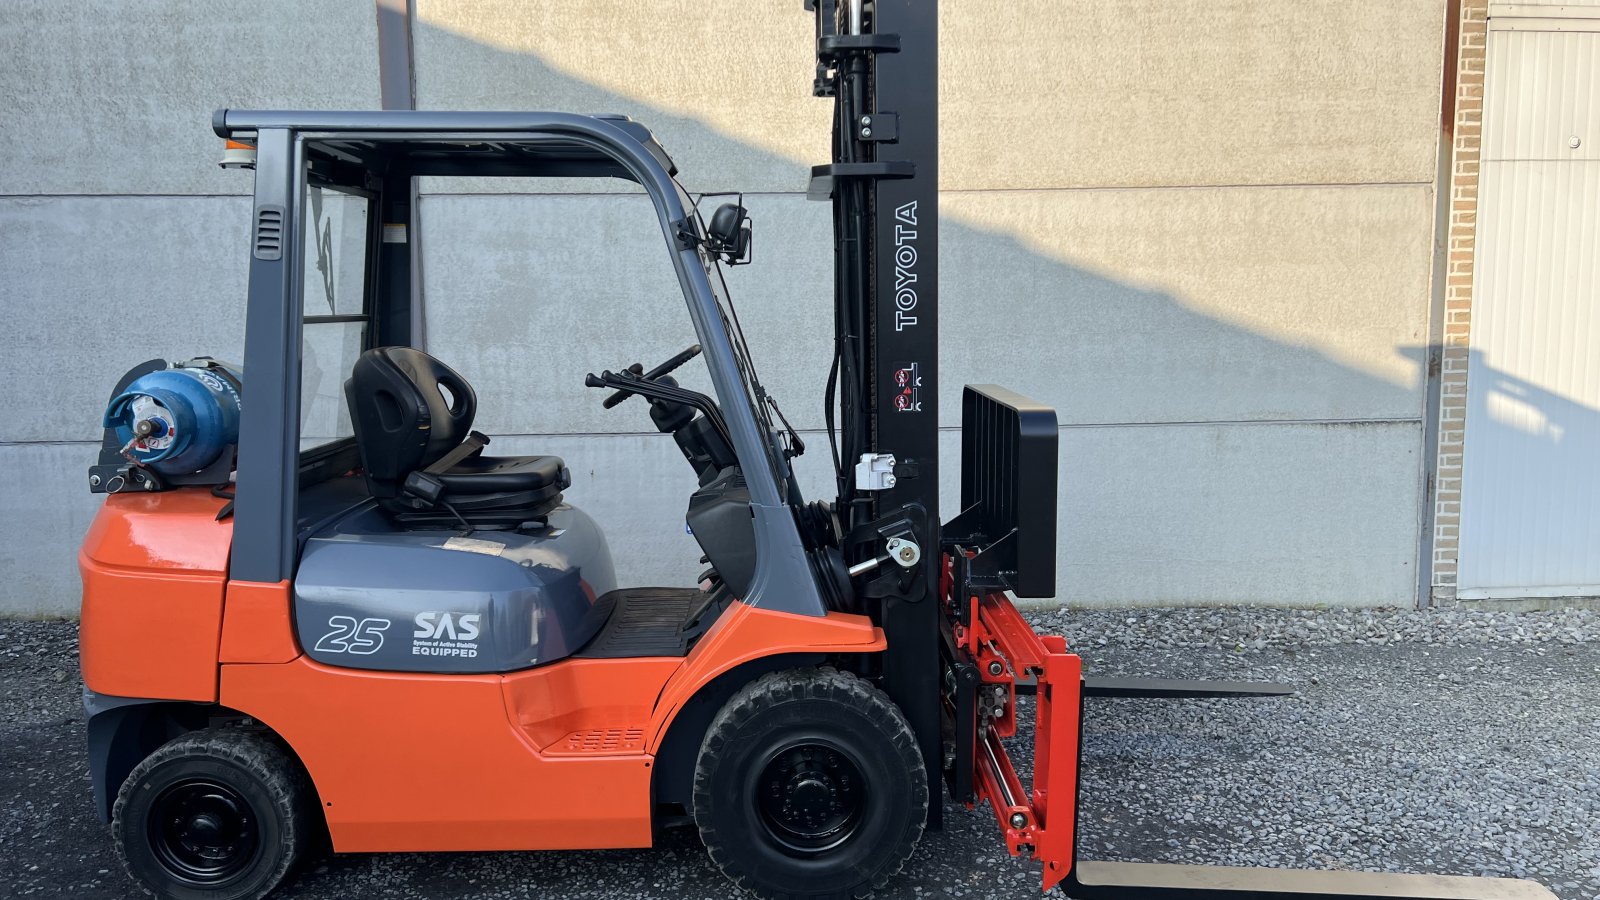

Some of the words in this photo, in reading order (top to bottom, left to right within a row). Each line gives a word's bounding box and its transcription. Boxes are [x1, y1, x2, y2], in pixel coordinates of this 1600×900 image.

[895, 200, 917, 331] TOYOTA
[314, 615, 391, 655] 25
[414, 612, 480, 641] SAS
[412, 646, 478, 658] EQUIPPED
[456, 642, 478, 650] Stability
